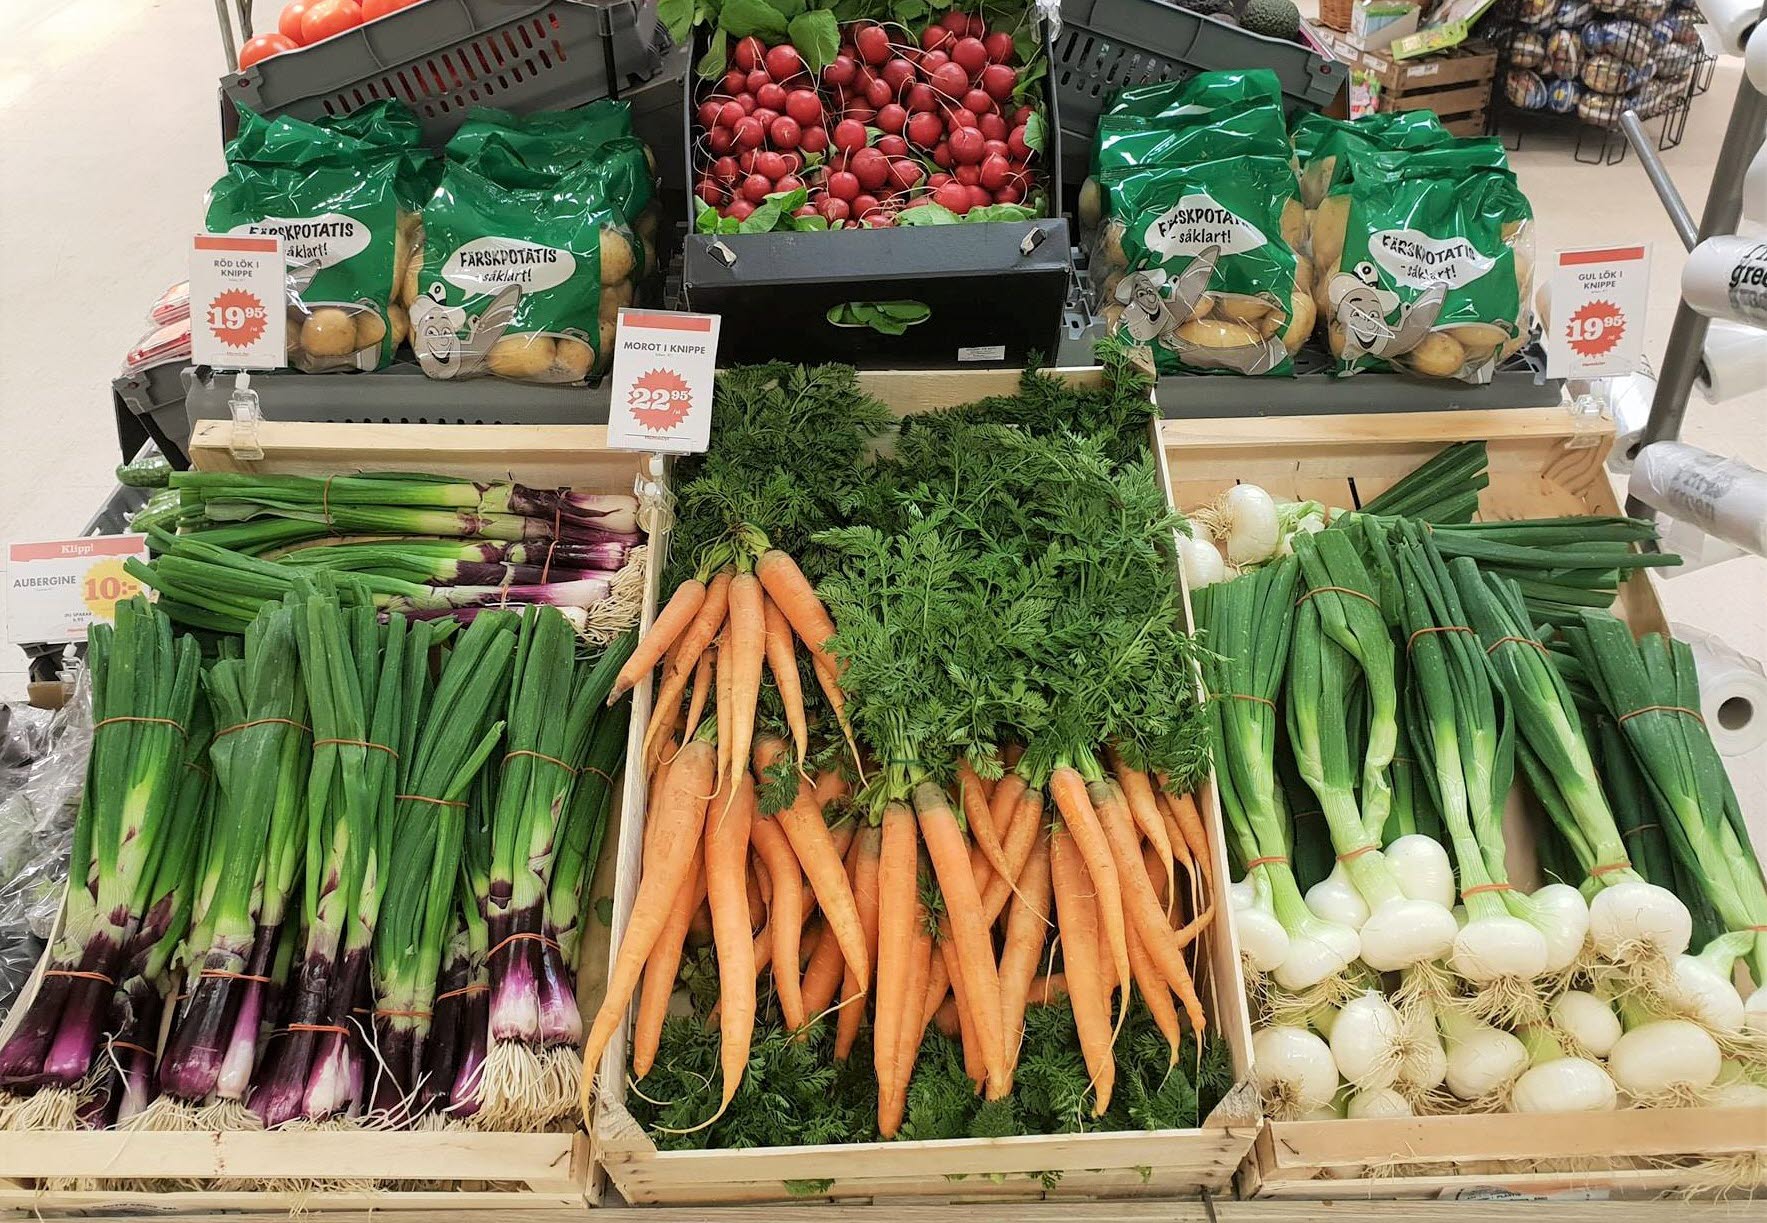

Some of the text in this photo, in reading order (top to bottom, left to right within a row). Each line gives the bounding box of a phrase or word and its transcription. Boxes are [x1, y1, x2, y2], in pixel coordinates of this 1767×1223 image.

[1158, 208, 1252, 237] FSKPOTA
[1179, 228, 1231, 243] såklart!
[285, 242, 328, 259] åklart!
[460, 248, 557, 267] FÄRSKPOTATIS
[213, 259, 233, 268] RÖD
[236, 260, 253, 268] LÖK
[1407, 264, 1457, 281] såklart!
[1578, 273, 1597, 281] GUL
[1599, 270, 1617, 280] LÖK
[1583, 280, 1616, 290] KNIPPE
[623, 341, 661, 352] MOROT
[669, 344, 706, 355] KNIPPE
[60, 543, 94, 555] Klipp!
[13, 575, 77, 589] AUBERGINE
